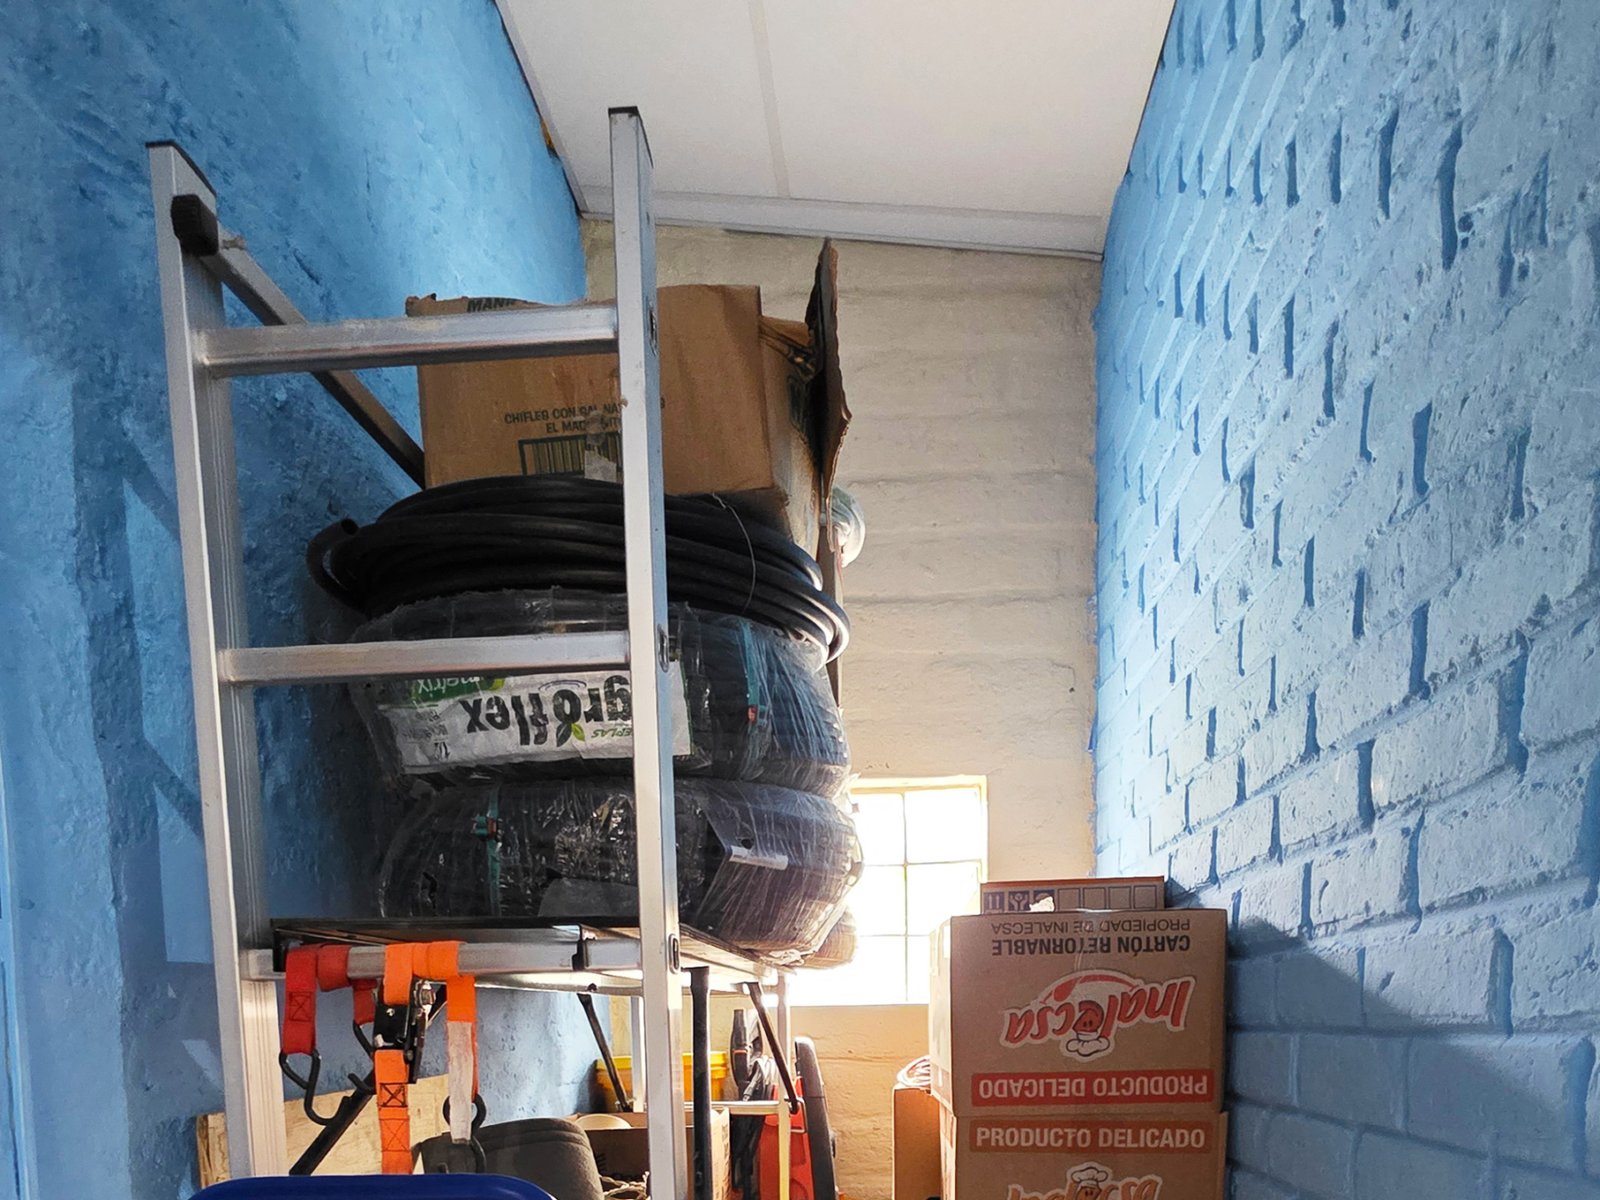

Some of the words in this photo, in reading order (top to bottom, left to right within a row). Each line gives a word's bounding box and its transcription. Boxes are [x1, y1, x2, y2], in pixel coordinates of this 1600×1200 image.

[504, 410, 550, 424] CHIFLES
[552, 407, 576, 420] CON
[546, 423, 558, 434] EL
[992, 921, 1069, 935] INALECSA
[992, 936, 1112, 956] RETORNABLE
[1118, 934, 1190, 959] CARTÓN
[979, 1077, 1086, 1099] DELICADO
[1093, 1074, 1208, 1097] PRODUCTO
[976, 1126, 1091, 1147] PRODUCTO
[1099, 1128, 1206, 1149] DELICADO
